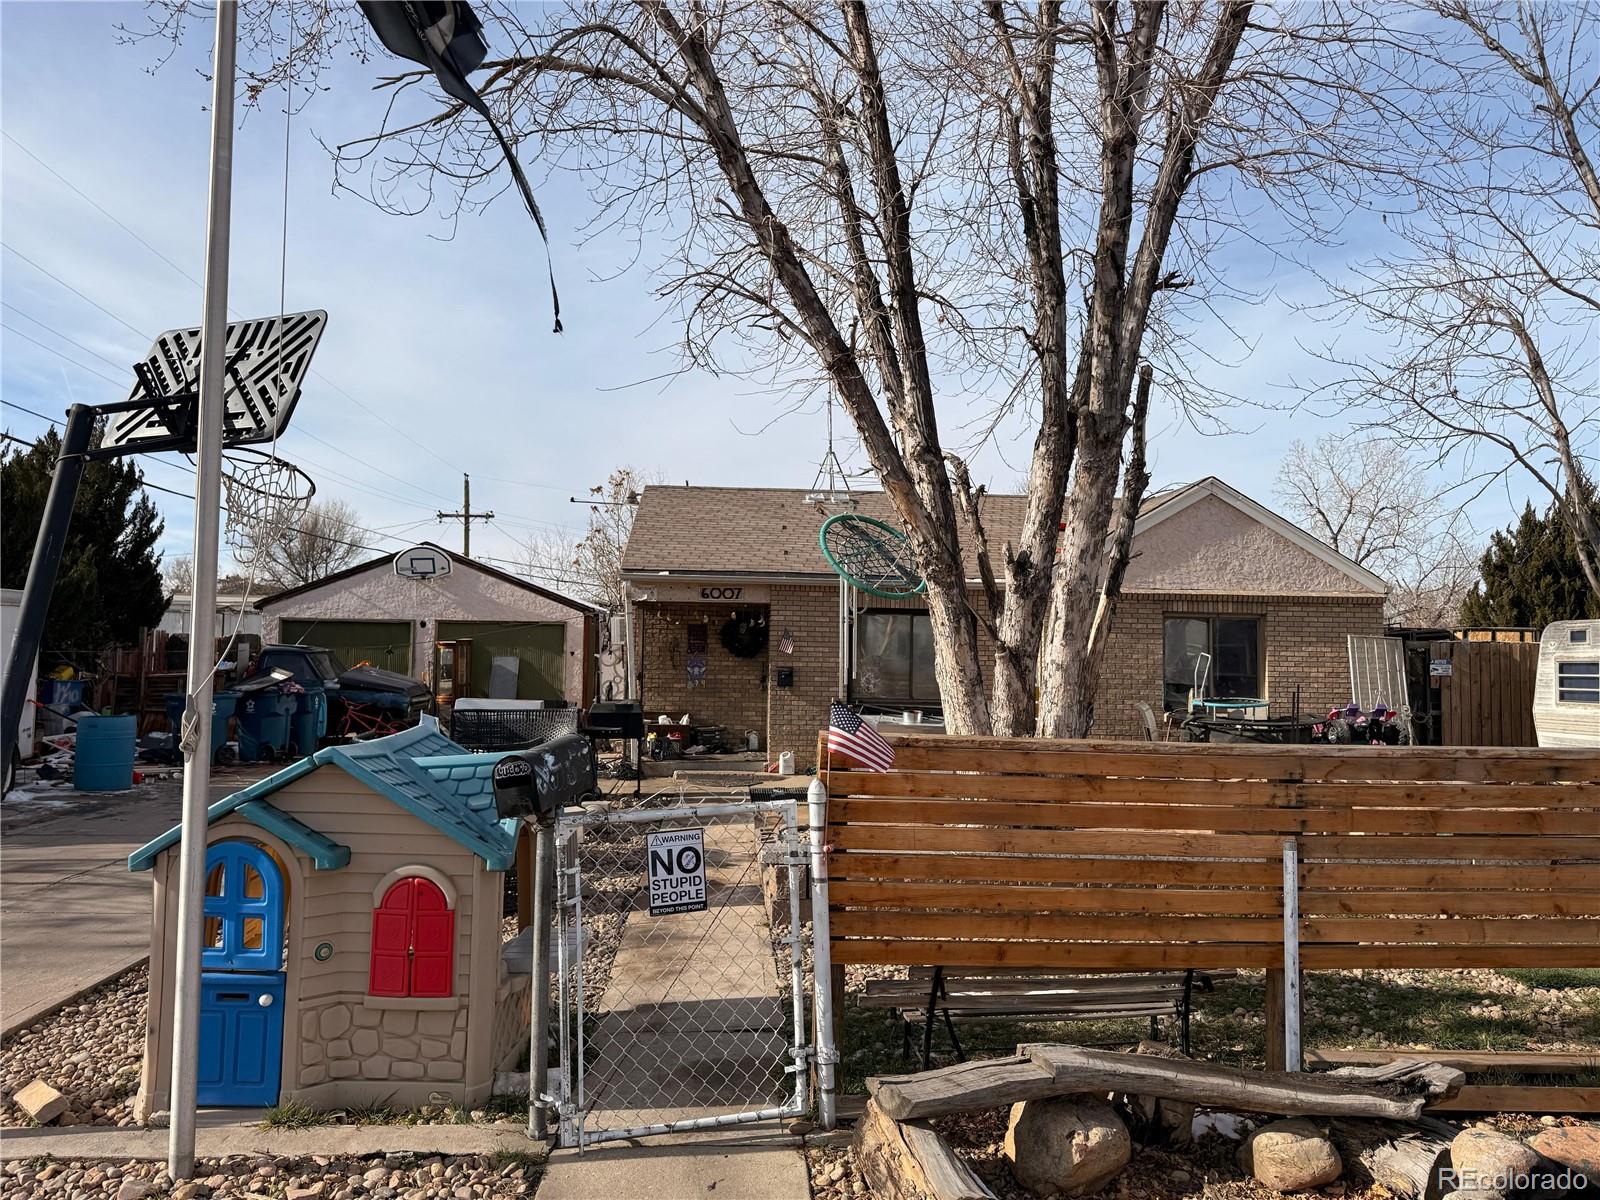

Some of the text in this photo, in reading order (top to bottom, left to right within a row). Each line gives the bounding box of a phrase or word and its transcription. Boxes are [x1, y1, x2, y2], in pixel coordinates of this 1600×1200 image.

[701, 587, 742, 599] 6007
[661, 833, 700, 843] WARNING
[651, 846, 701, 877] NO
[652, 875, 702, 891] STUPID
[652, 889, 703, 904] PEOPLE
